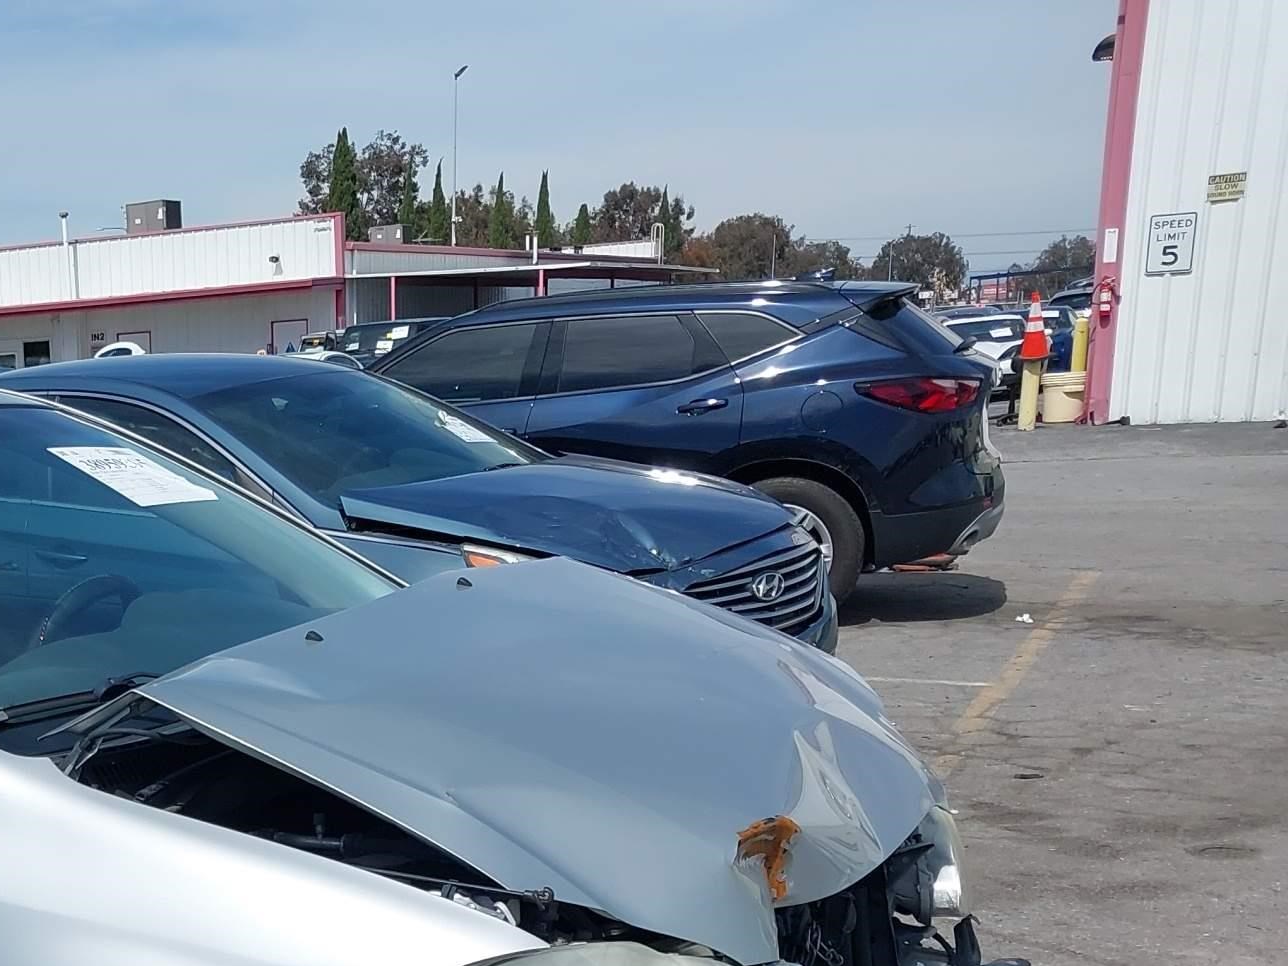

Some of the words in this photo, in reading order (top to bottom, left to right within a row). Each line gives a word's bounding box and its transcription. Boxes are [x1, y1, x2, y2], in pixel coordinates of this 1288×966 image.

[1209, 173, 1246, 184] CAUTION
[1215, 183, 1239, 191] SLOW
[1153, 219, 1193, 230] SPEED
[1156, 231, 1188, 242] LIMIT
[1161, 244, 1179, 266] 5
